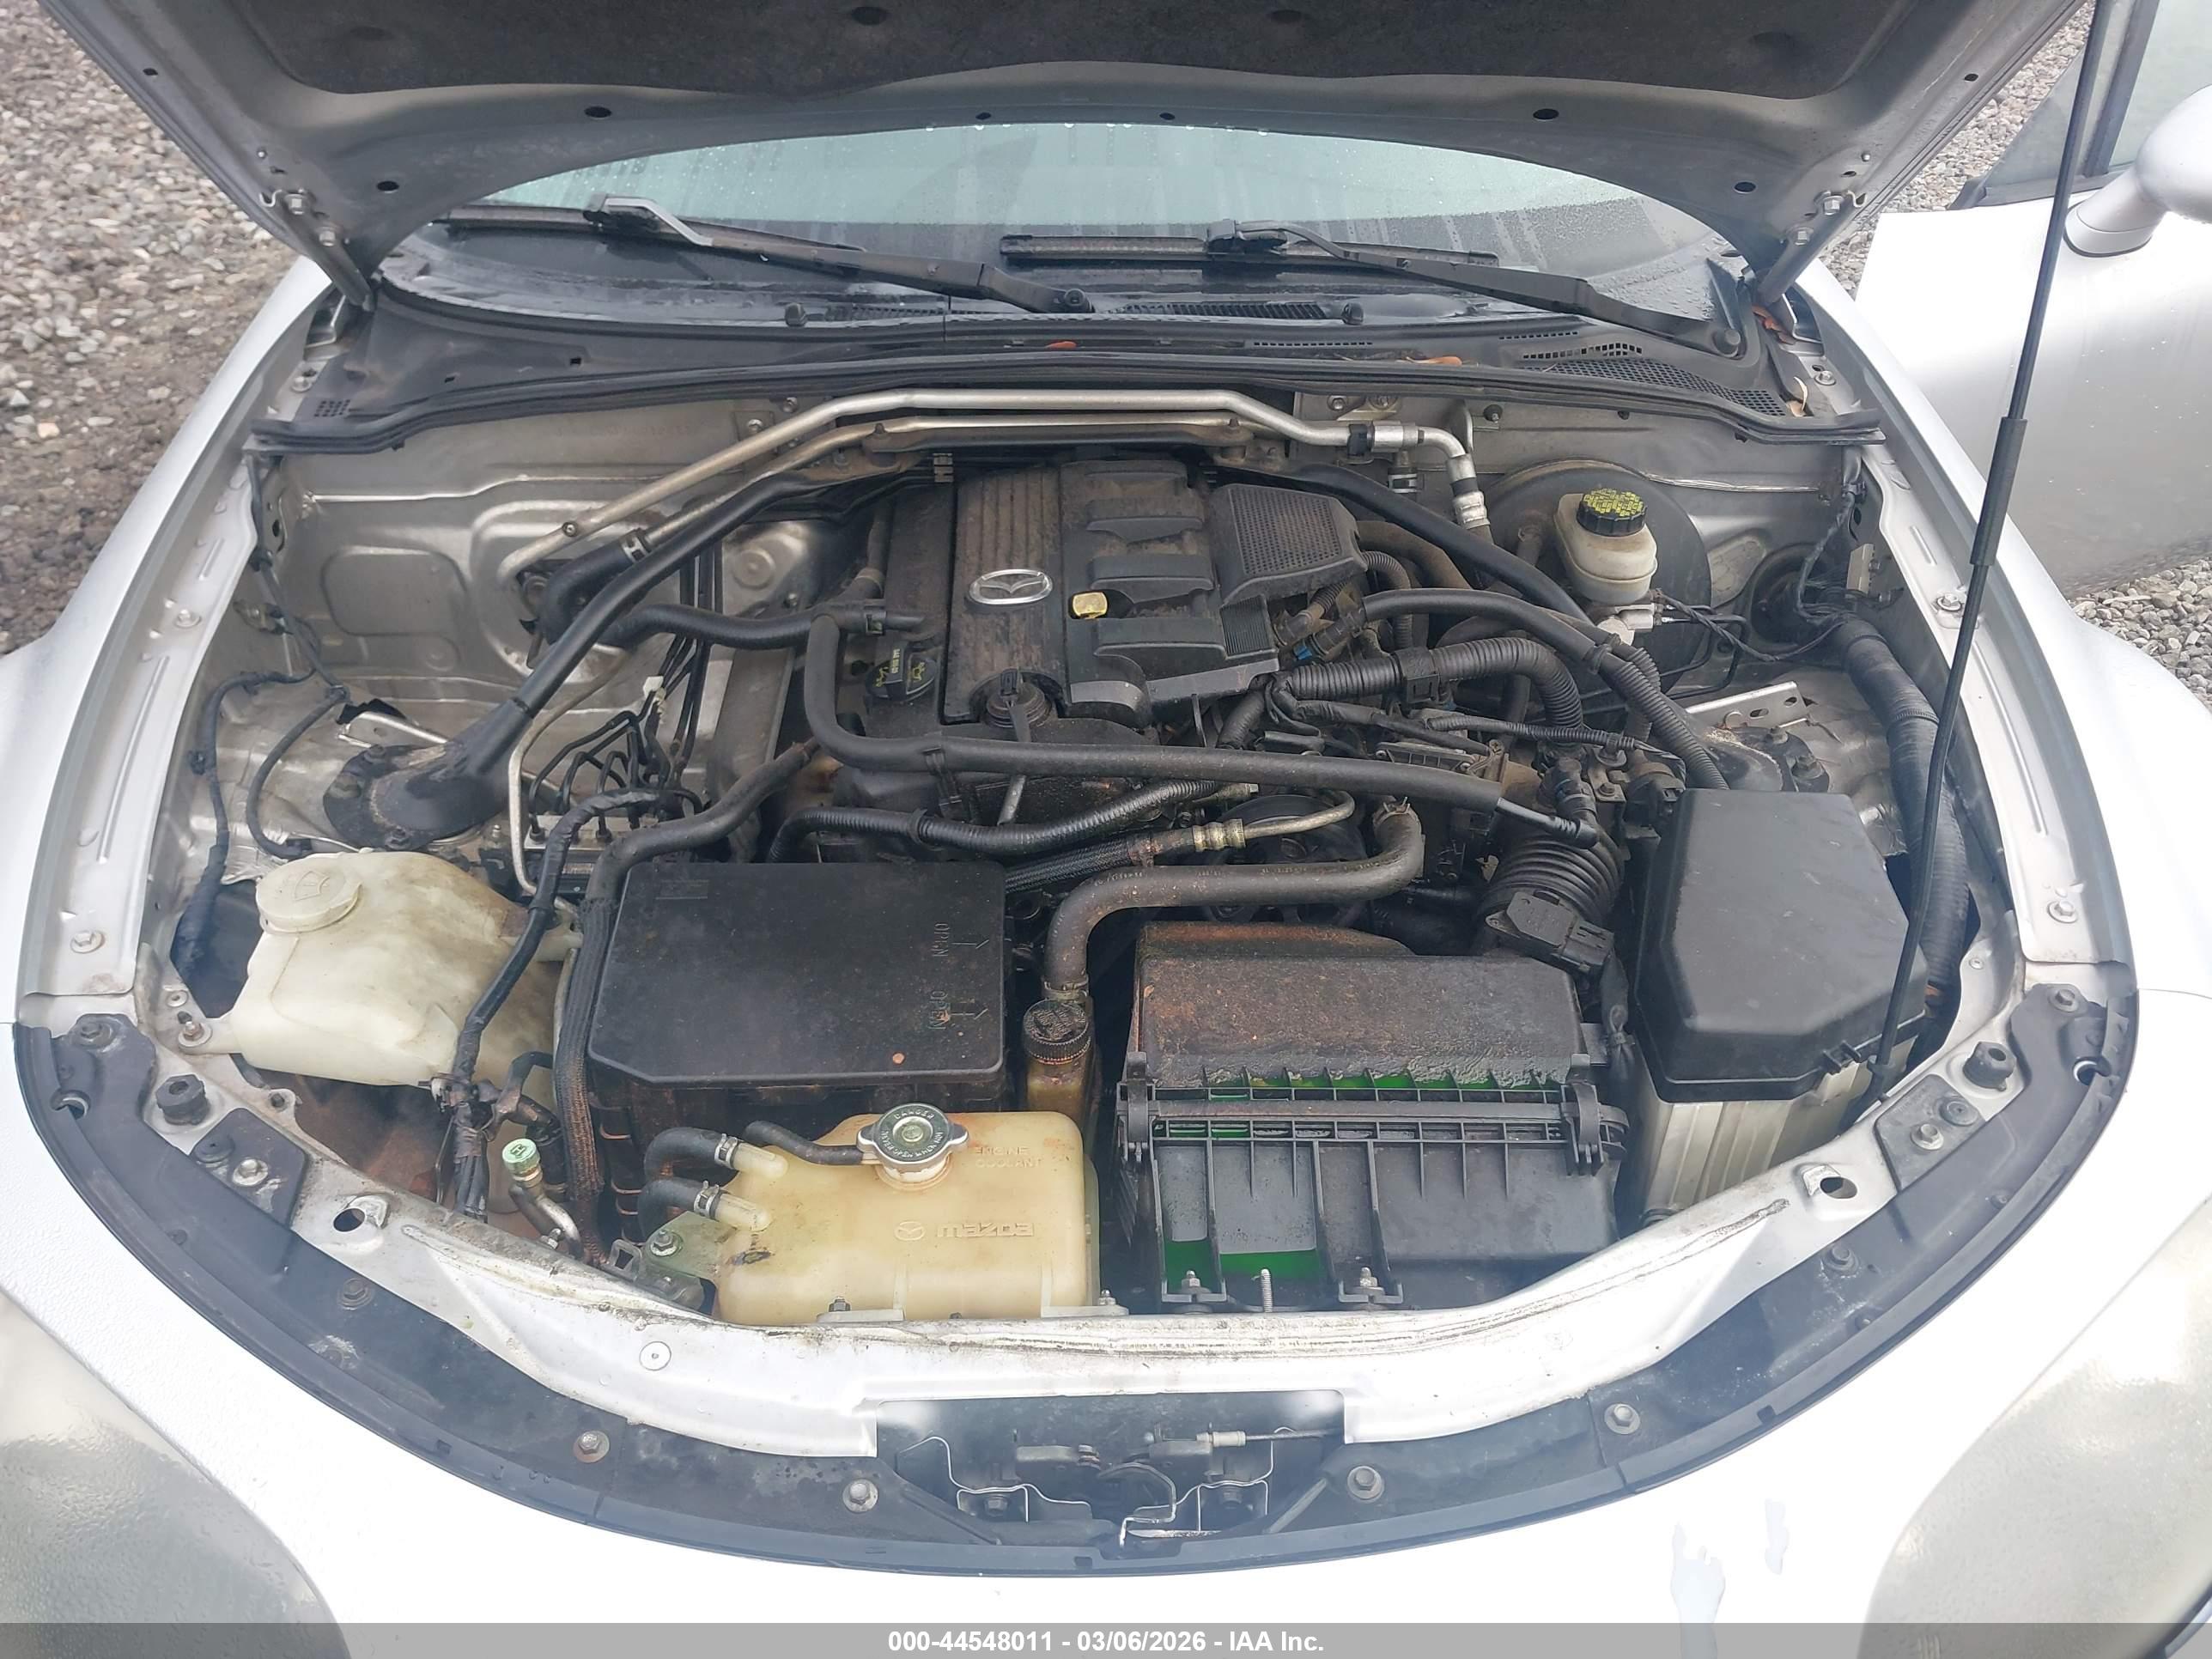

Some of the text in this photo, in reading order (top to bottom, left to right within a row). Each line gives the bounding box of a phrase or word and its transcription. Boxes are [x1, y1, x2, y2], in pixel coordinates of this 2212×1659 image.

[932, 923, 950, 957] OPEN
[927, 990, 951, 1030] OPEN
[975, 1146, 1030, 1156] ENGINE
[975, 1156, 1042, 1168] COOLANT
